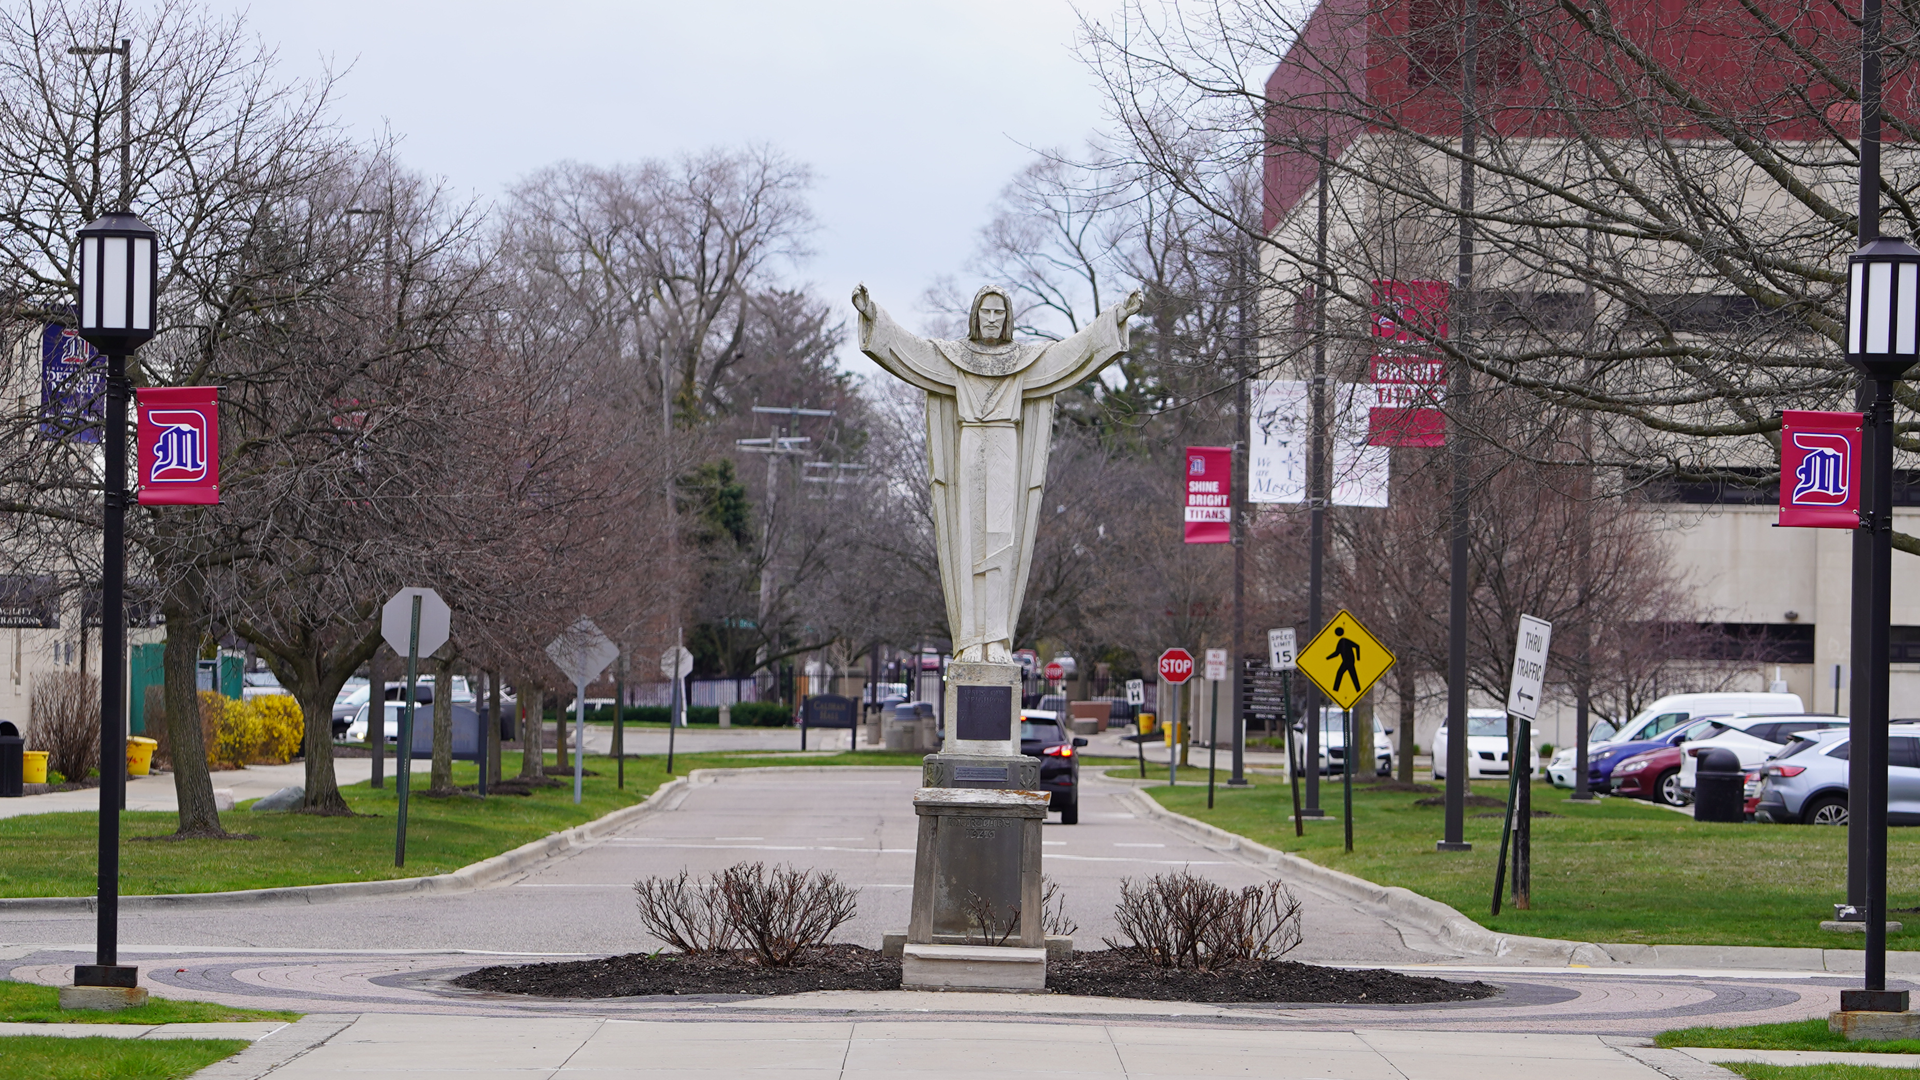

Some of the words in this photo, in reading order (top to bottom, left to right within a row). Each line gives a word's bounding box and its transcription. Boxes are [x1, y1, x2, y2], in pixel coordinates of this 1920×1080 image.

[46, 370, 101, 383] DETOIT
[1257, 457, 1271, 467] We
[1188, 480, 1219, 493] SHINE
[1253, 478, 1303, 495] Mercy
[1188, 494, 1228, 507] BRIGHT
[1189, 509, 1225, 519] TITANS
[1525, 631, 1543, 654] THRU
[1275, 650, 1292, 663] 15
[1045, 667, 1063, 678] STOP
[1161, 658, 1192, 674] STOP
[1517, 658, 1542, 682] TRAFFIC
[1127, 681, 1141, 690] LOT
[1131, 690, 1141, 702] H
